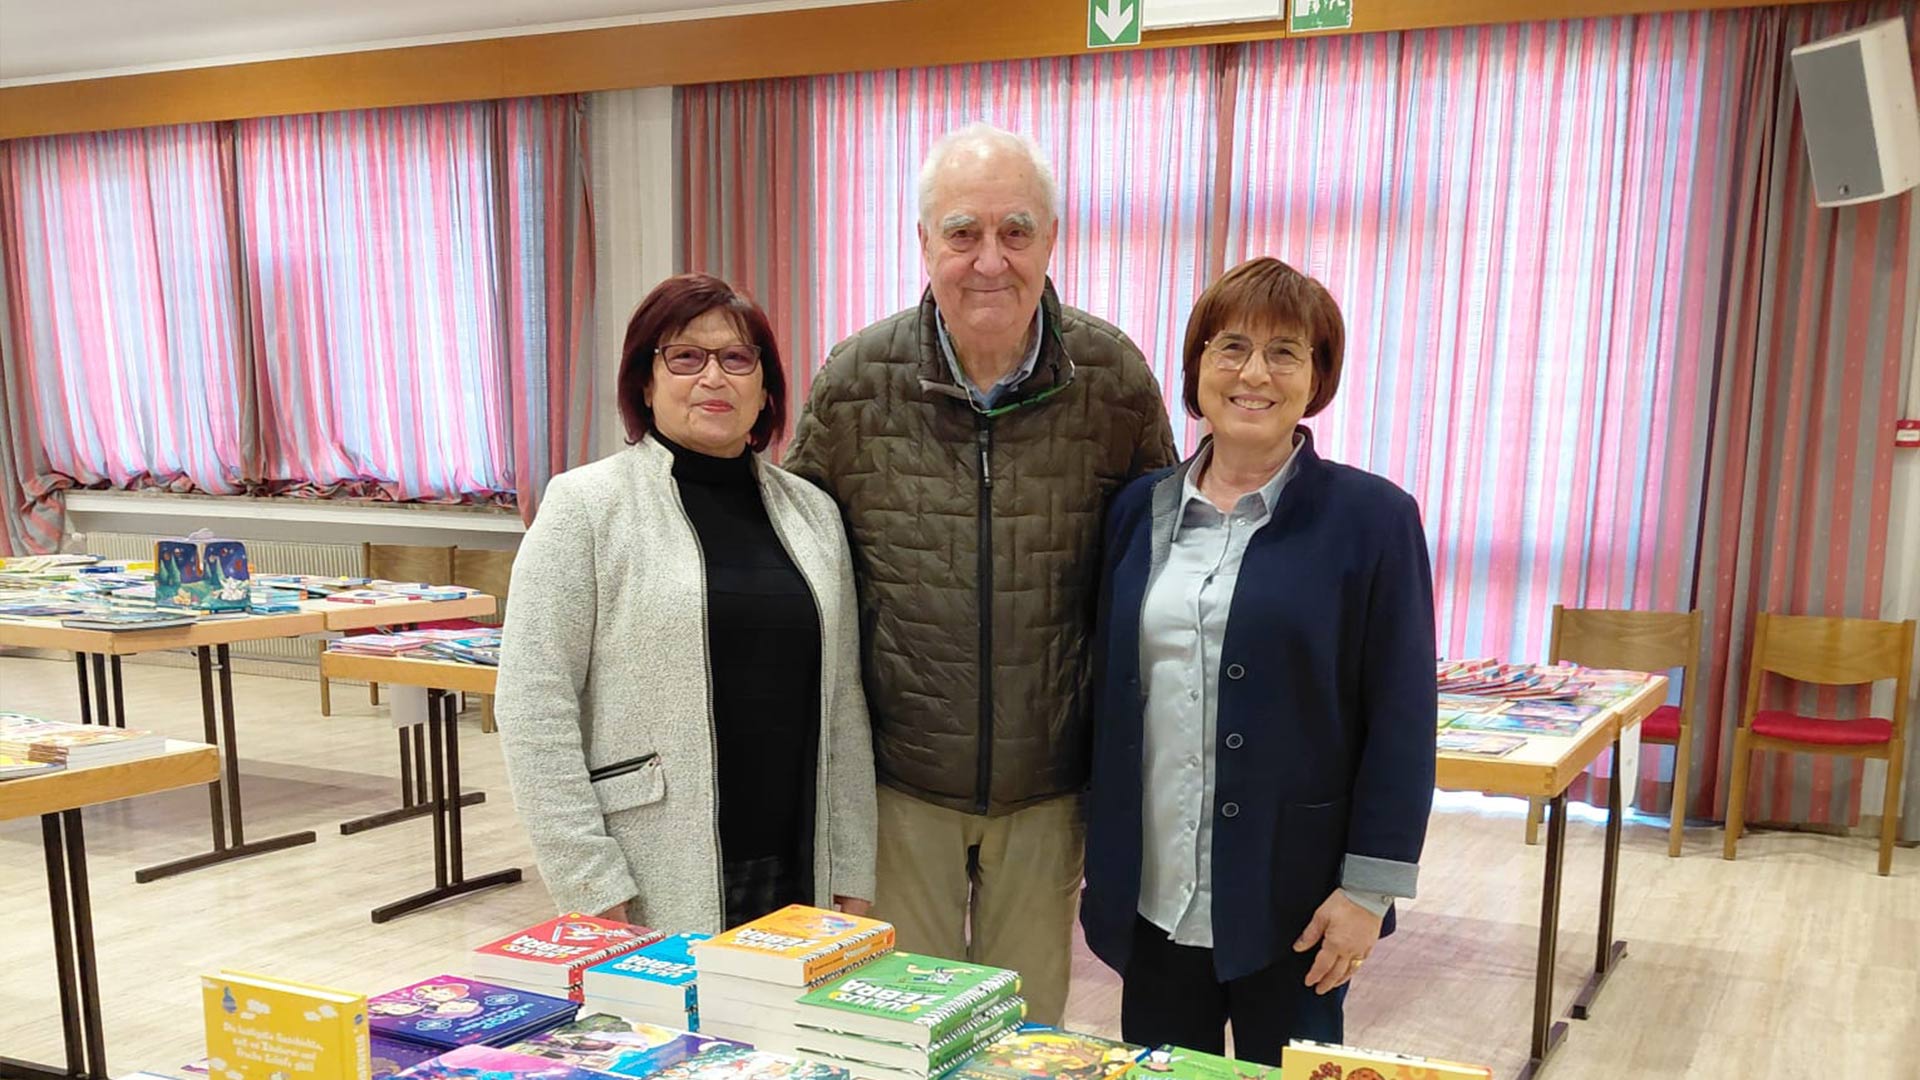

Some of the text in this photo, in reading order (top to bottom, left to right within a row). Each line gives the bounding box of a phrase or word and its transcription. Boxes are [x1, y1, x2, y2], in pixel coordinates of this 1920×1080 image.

[511, 935, 592, 955] ZEBRA
[736, 928, 820, 948] ZEBRA
[835, 992, 911, 1011] JULIUS
[838, 979, 946, 1006] ZEBRA
